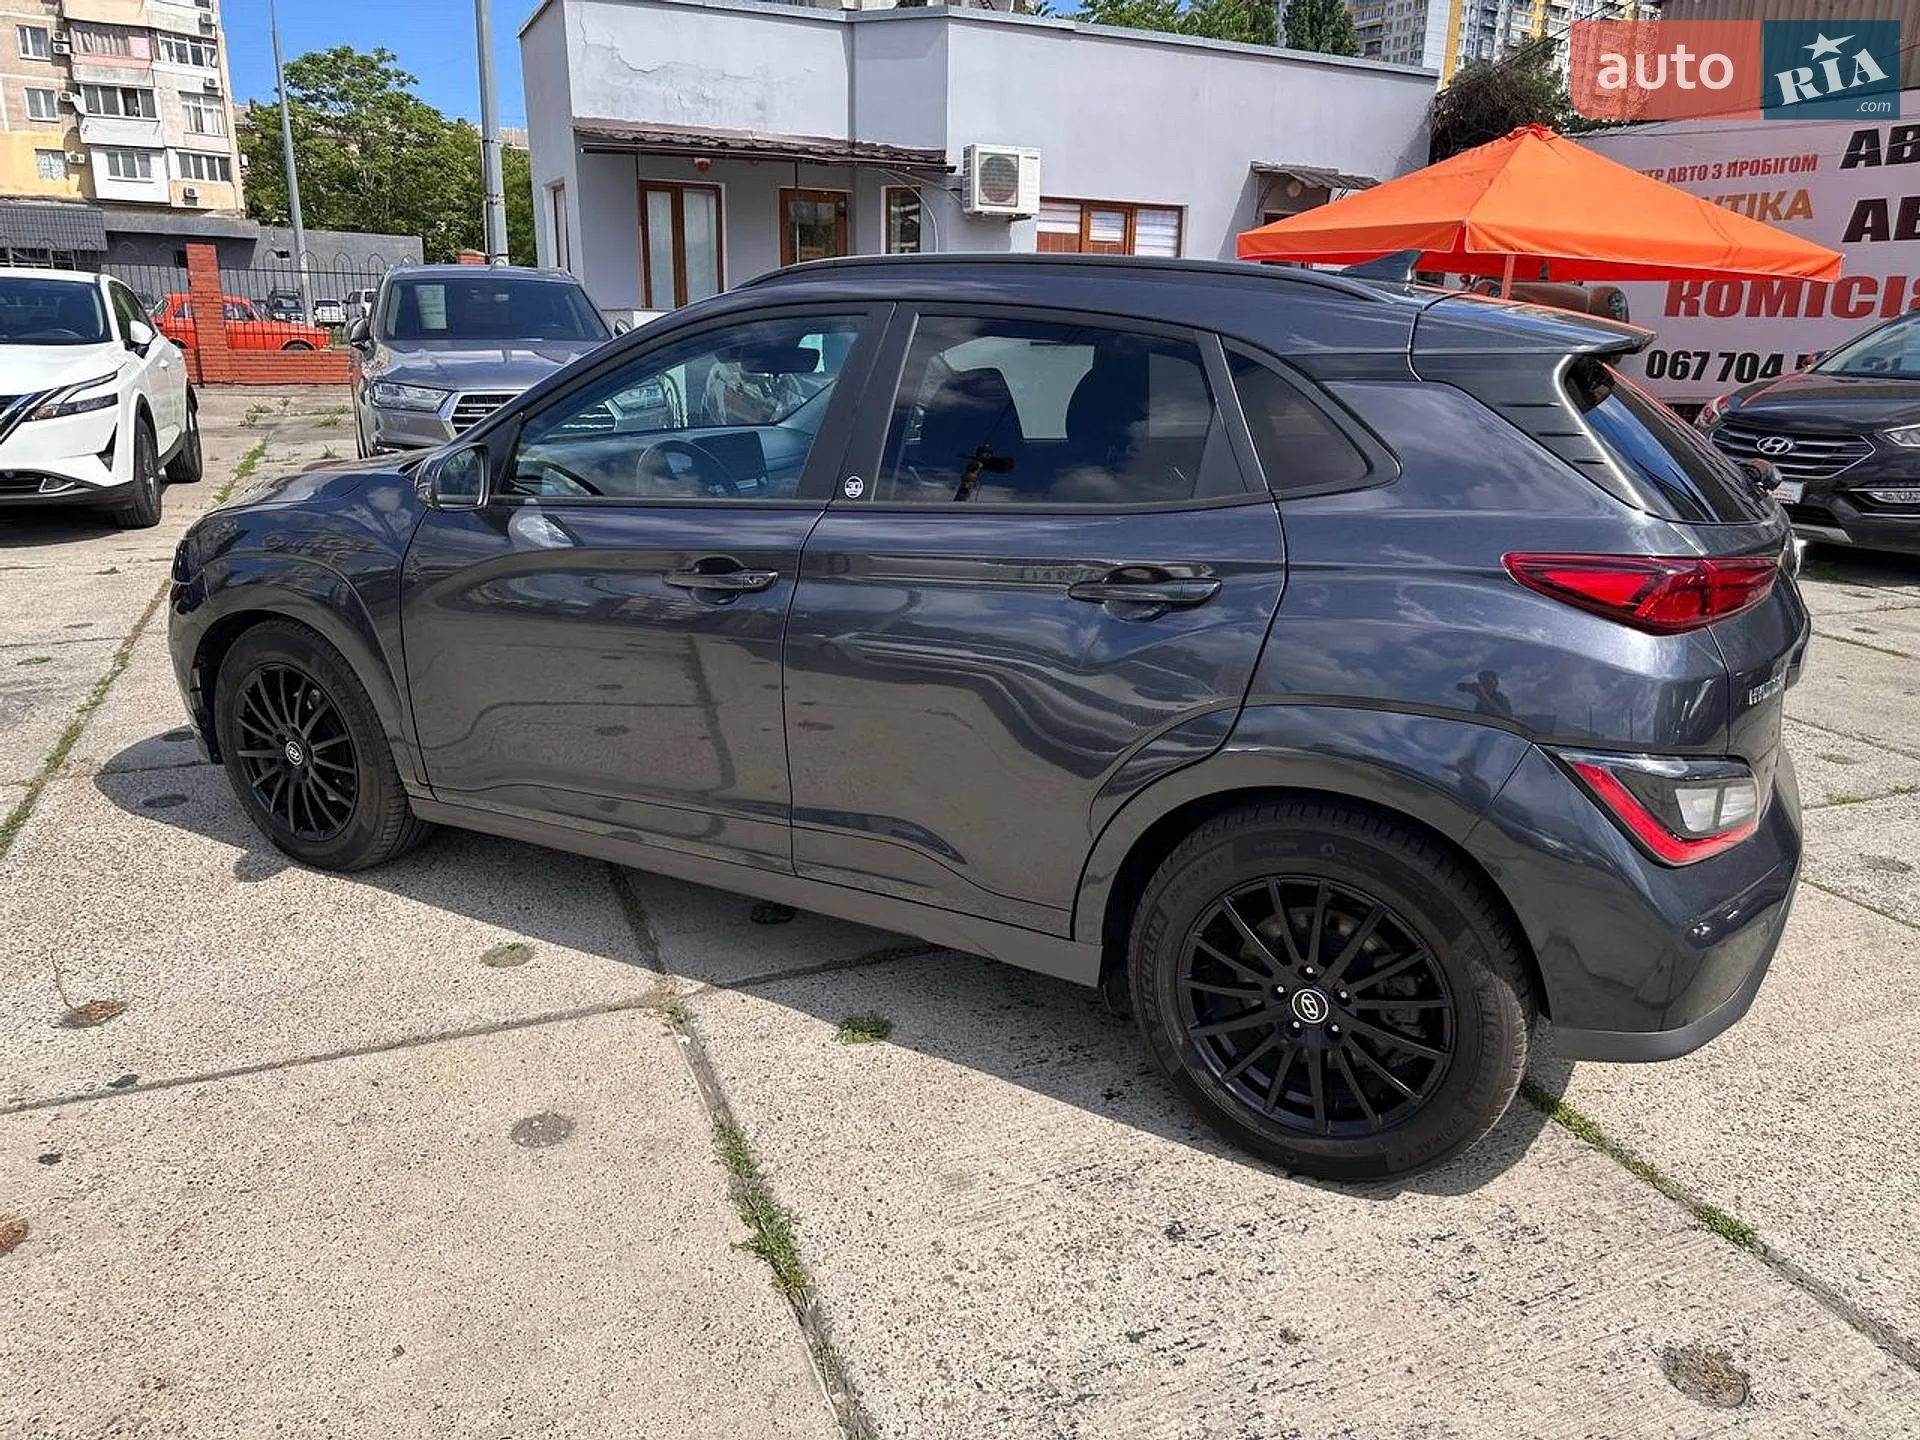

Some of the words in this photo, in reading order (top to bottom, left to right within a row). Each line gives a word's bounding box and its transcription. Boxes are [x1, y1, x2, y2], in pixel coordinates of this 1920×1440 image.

[1666, 164, 1709, 184] АВТО
[1711, 162, 1723, 180] З
[1726, 153, 1818, 178] ПРОБІГОМ
[1645, 350, 1710, 381] 067
[1716, 352, 1784, 384] 704
